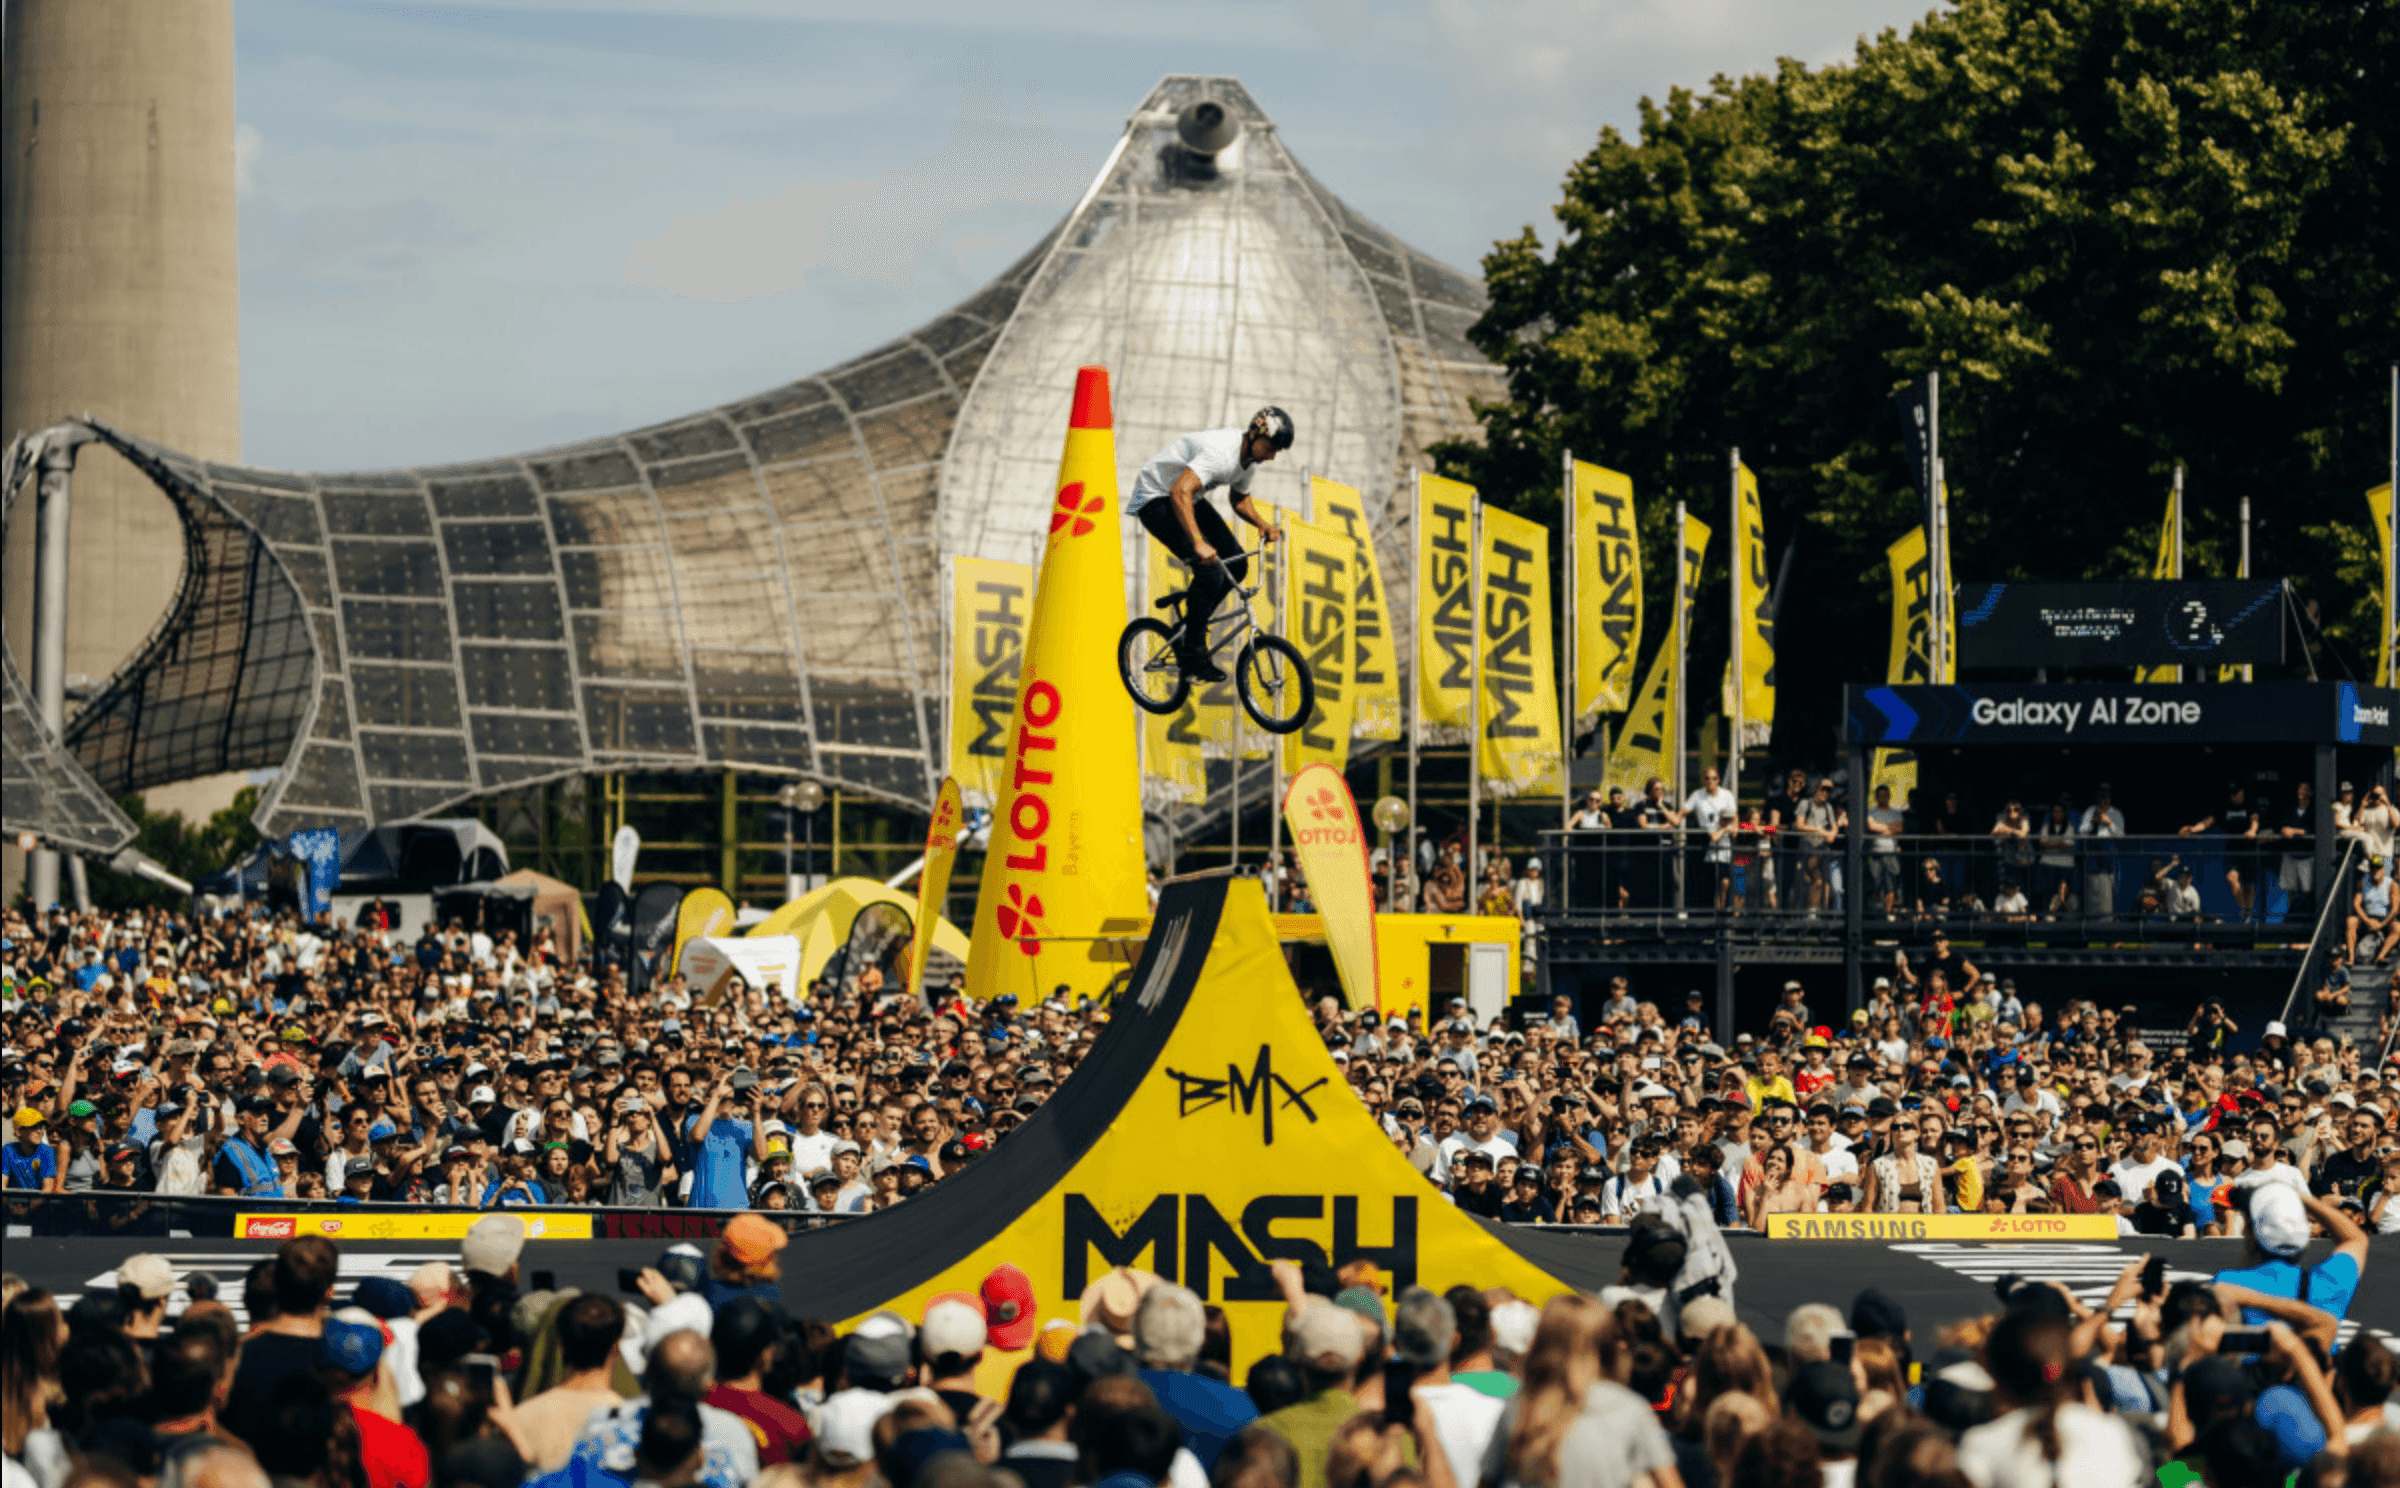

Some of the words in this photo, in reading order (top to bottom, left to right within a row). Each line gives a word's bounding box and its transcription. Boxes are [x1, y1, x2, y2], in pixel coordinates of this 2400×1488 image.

[1302, 548, 1346, 752] MASH
[1432, 503, 1473, 689] MASH
[1485, 537, 1539, 740] MASH
[967, 581, 1024, 757] MASH
[1972, 698, 2081, 733] Galaxy
[2089, 698, 2117, 724] AI
[2125, 698, 2201, 724] Zone
[1006, 680, 1062, 872] LOTTO
[1165, 1043, 1328, 1146] BMX
[1063, 1193, 1419, 1303] MASH
[1786, 1219, 1927, 1240] SAMSUNG
[2013, 1219, 2066, 1233] LOTTO
